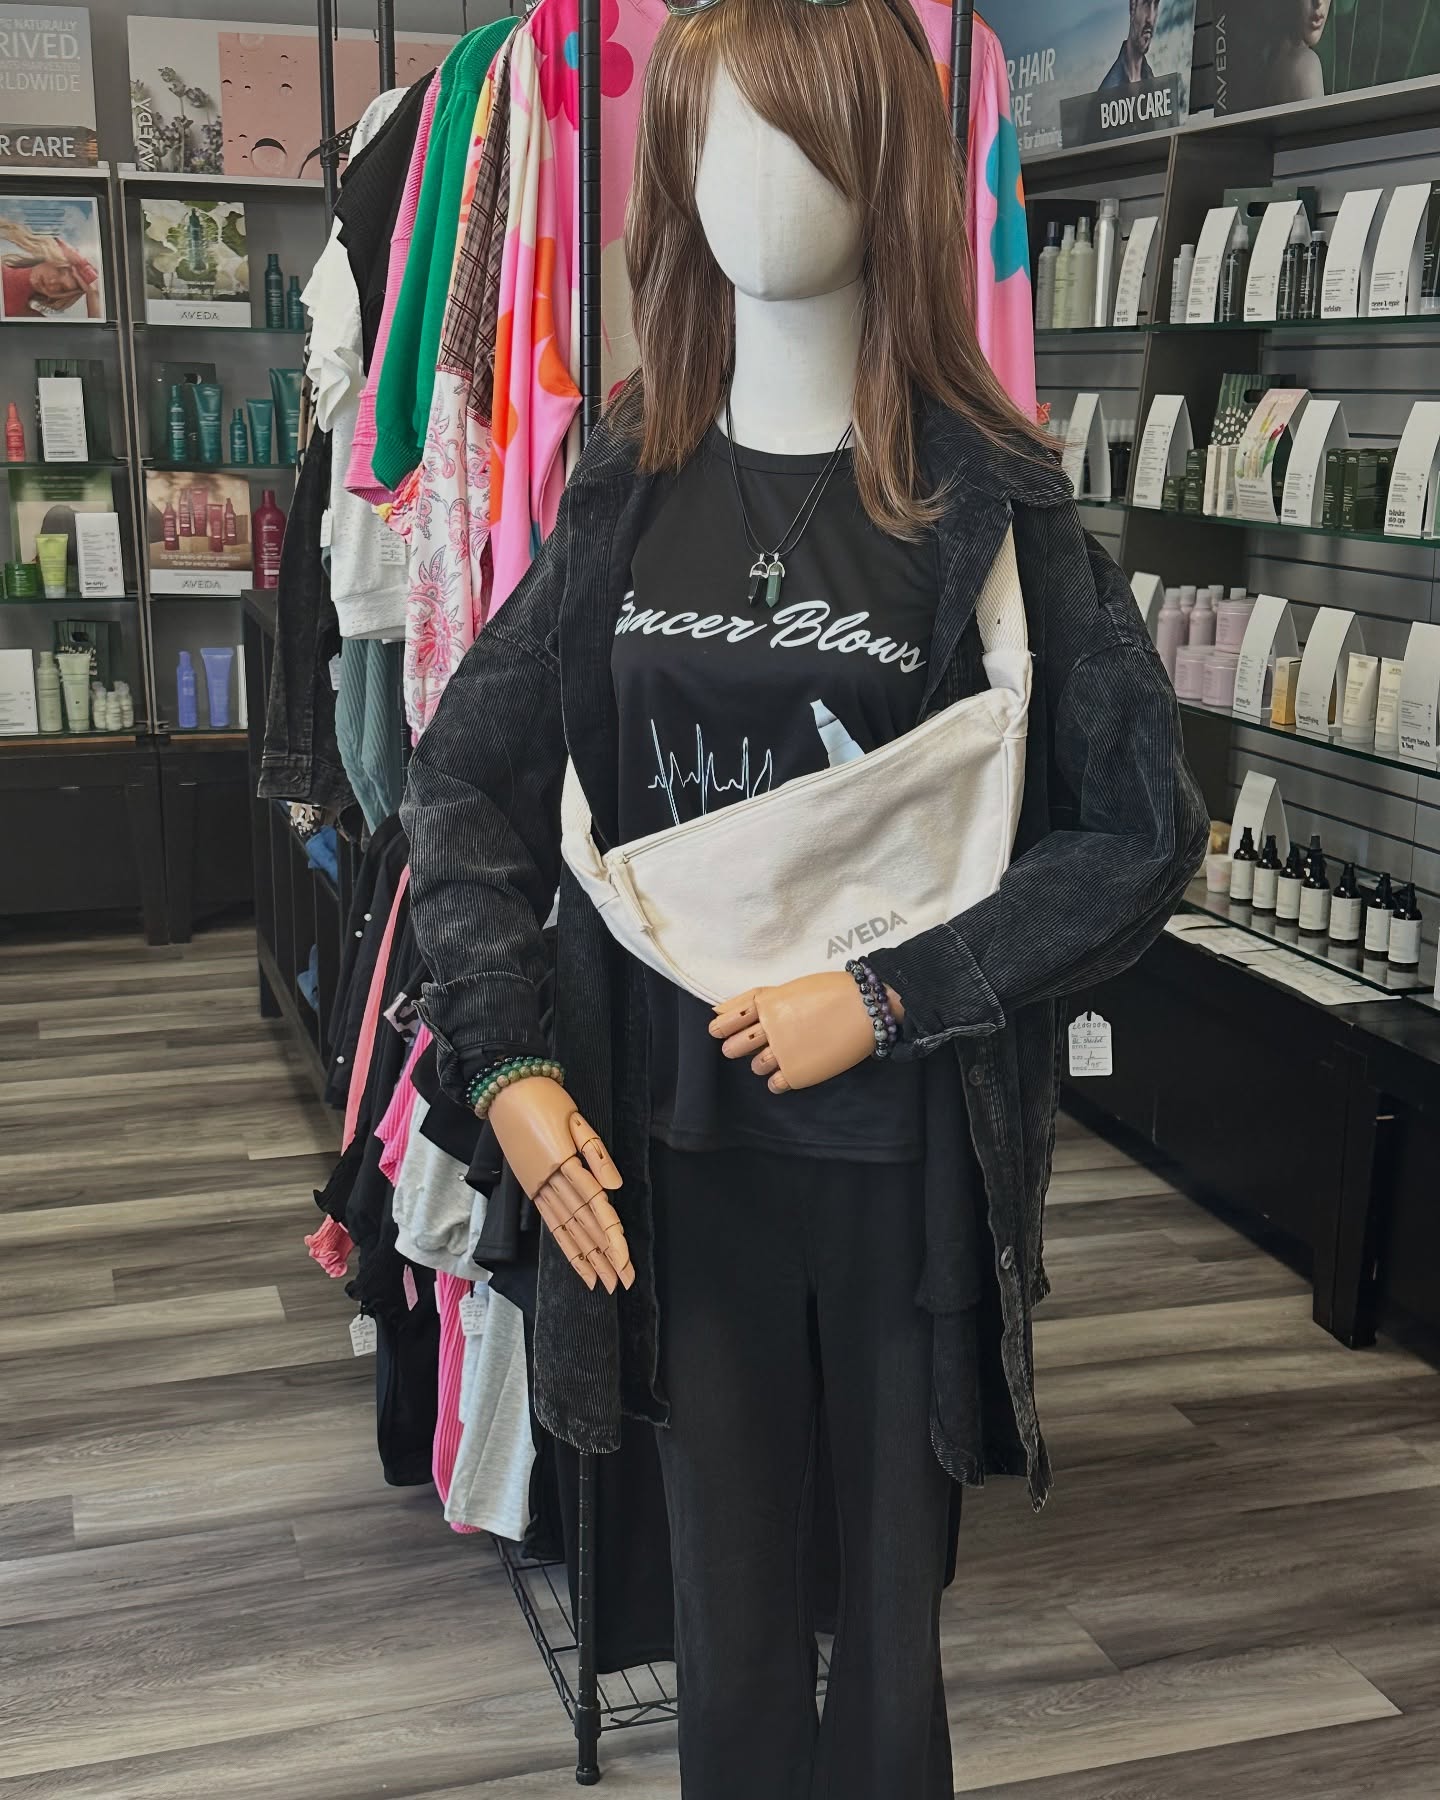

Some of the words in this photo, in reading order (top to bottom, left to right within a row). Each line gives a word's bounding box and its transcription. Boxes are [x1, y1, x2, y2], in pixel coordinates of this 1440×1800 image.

[1019, 48, 1056, 90] HAIR
[1215, 14, 1229, 111] AVEDA
[1101, 96, 1136, 129] BODY
[1137, 88, 1172, 121] CARE
[16, 134, 77, 158] CARE
[133, 98, 156, 170] AVEDA
[181, 311, 220, 321] AVEDA
[182, 580, 222, 589] AVEDA
[769, 600, 926, 673] Blows
[826, 910, 907, 960] AVEDA
